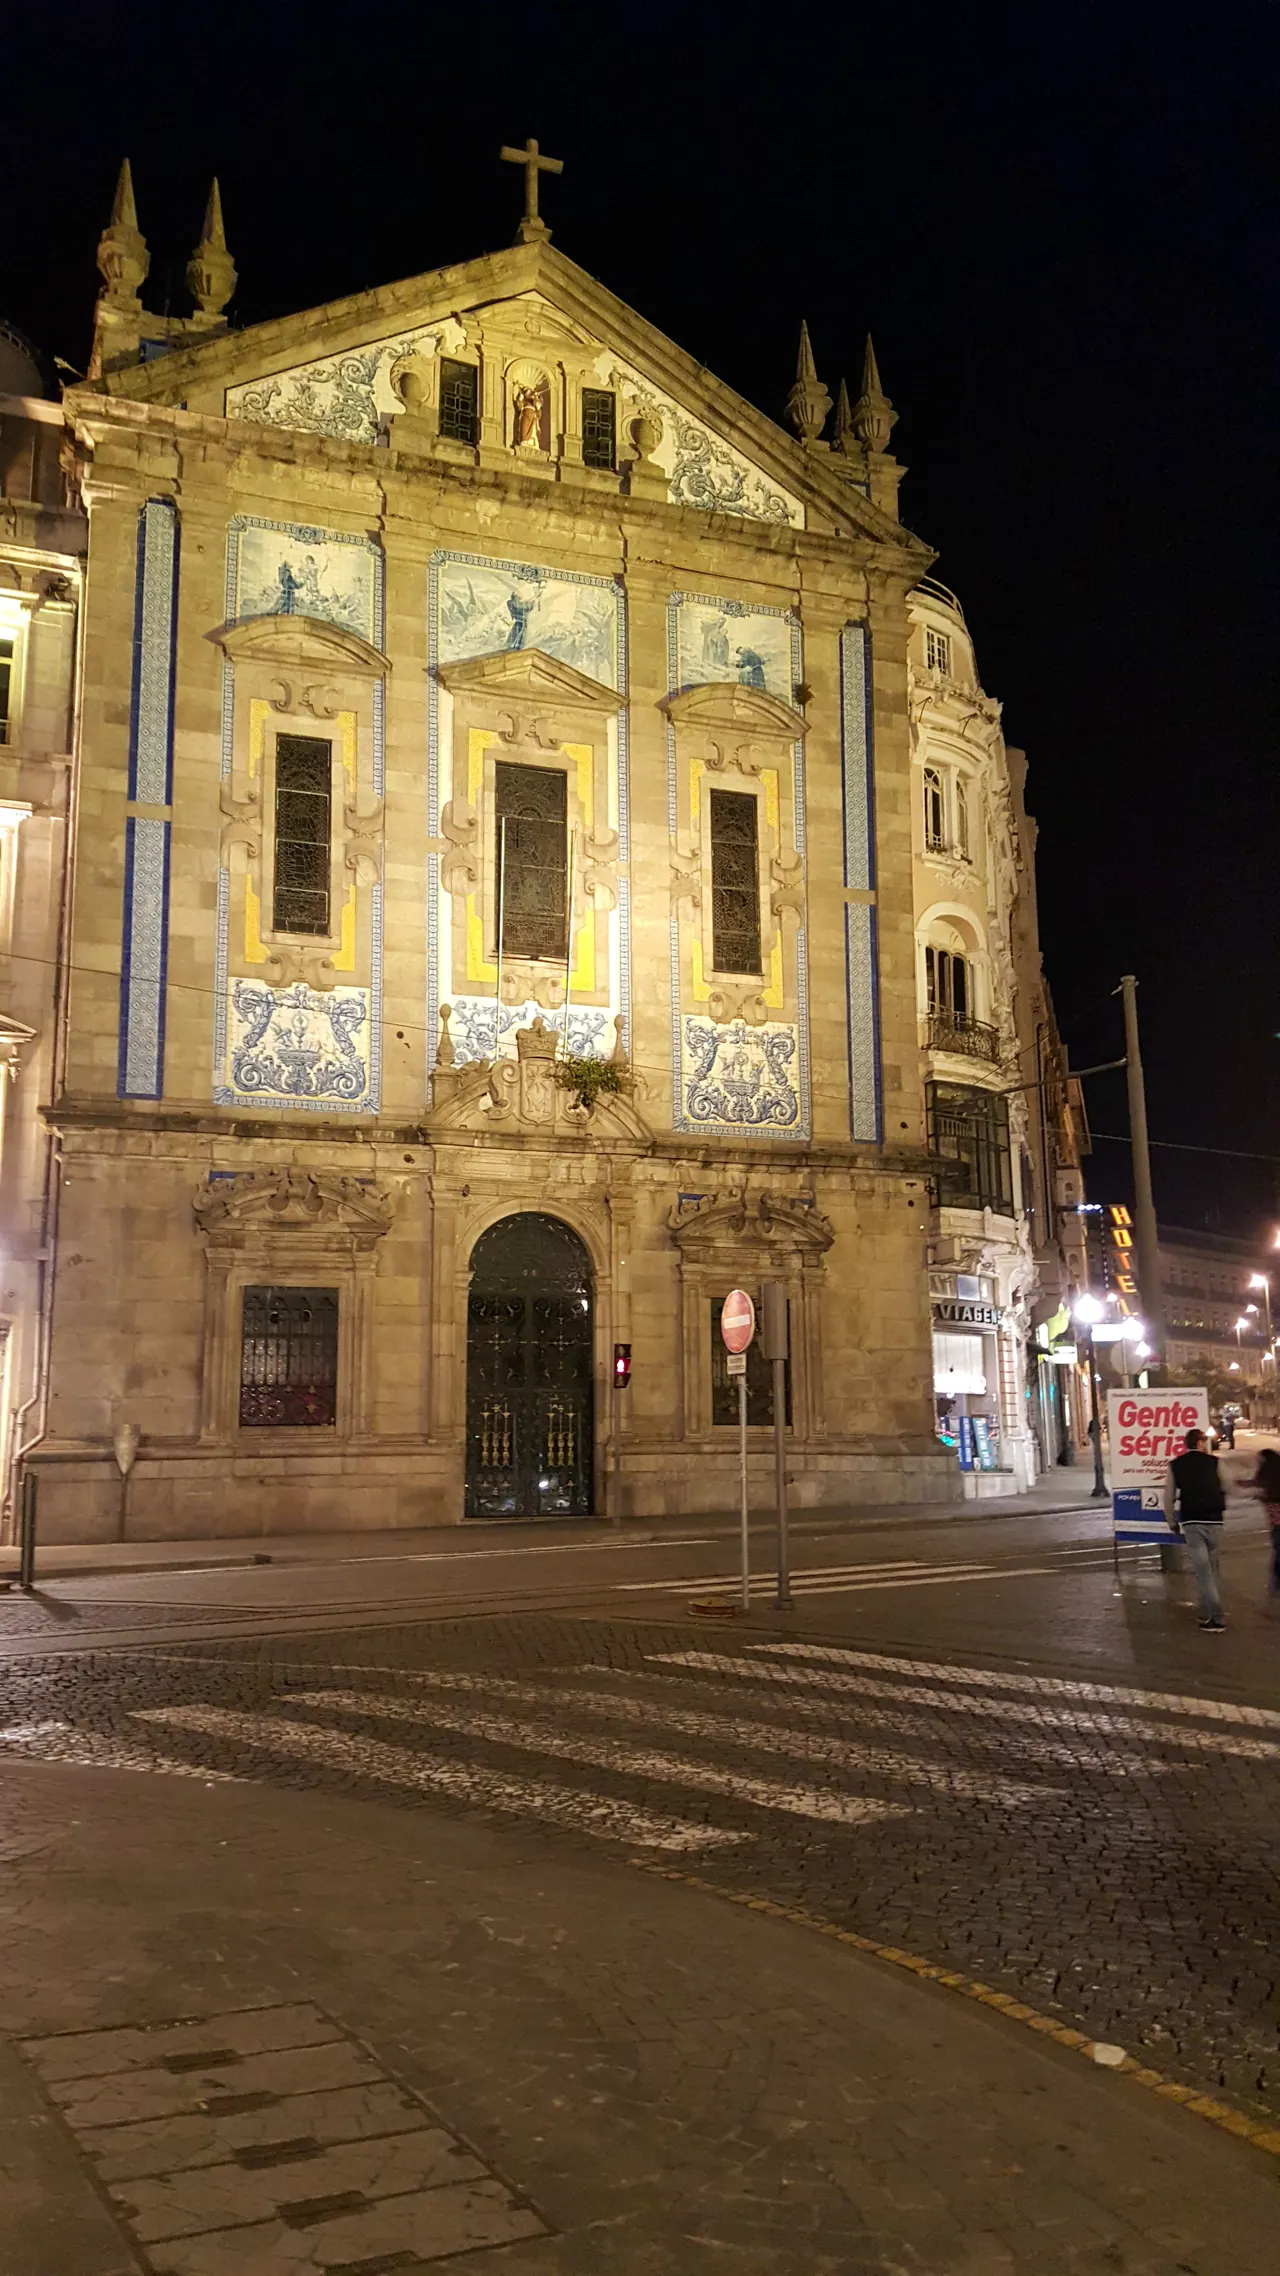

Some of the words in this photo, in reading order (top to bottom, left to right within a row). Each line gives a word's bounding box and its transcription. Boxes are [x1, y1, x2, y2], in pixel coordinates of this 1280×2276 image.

[1111, 1206, 1139, 1317] HOTEL
[1118, 1400, 1198, 1428] Gente
[1119, 1429, 1188, 1456] séria
[1141, 1458, 1169, 1468] soluçõ
